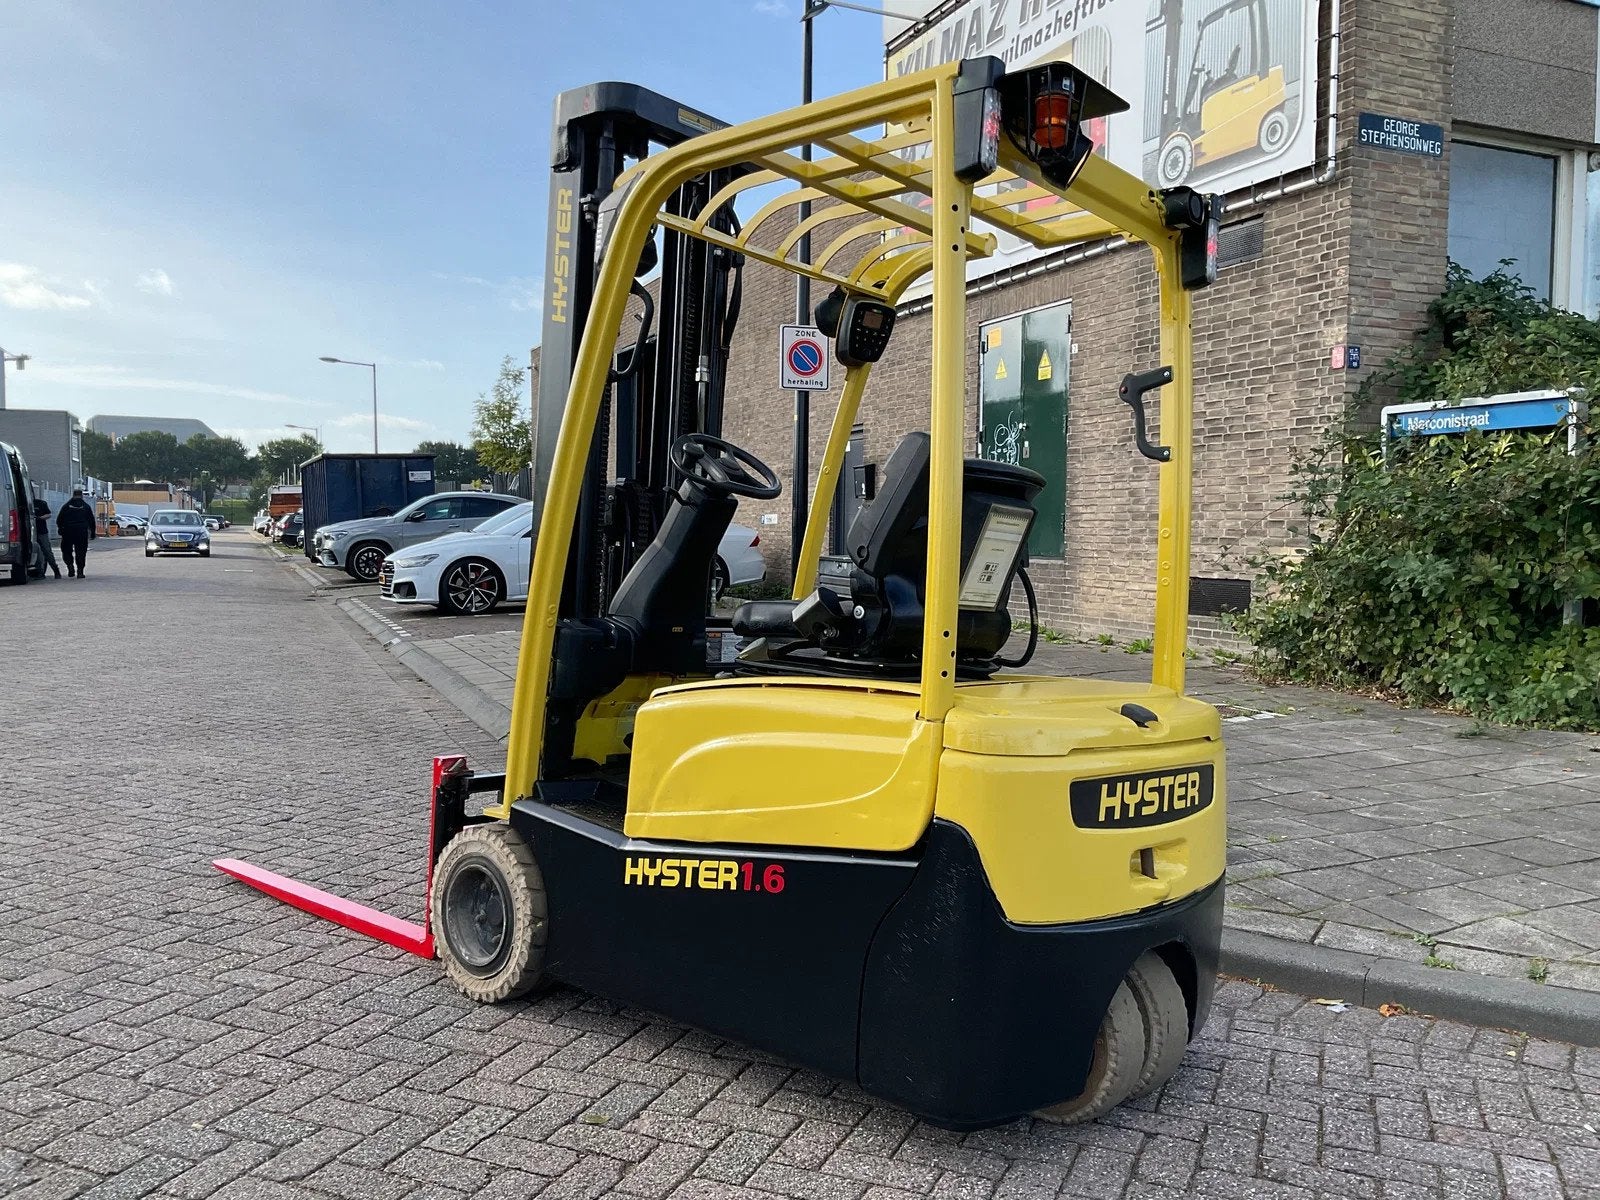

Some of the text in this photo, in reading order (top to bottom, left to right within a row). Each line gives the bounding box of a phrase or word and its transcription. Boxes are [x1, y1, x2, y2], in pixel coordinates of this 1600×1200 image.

[1383, 118, 1421, 137] GEORGE
[1361, 128, 1441, 155] STEPHENSONWEG
[552, 188, 573, 323] HYSTER
[787, 378, 824, 387] herhaling
[1407, 410, 1490, 431] Marconistraat
[1098, 771, 1200, 822] HYSTER
[624, 857, 785, 894] HYSTER 1.6
